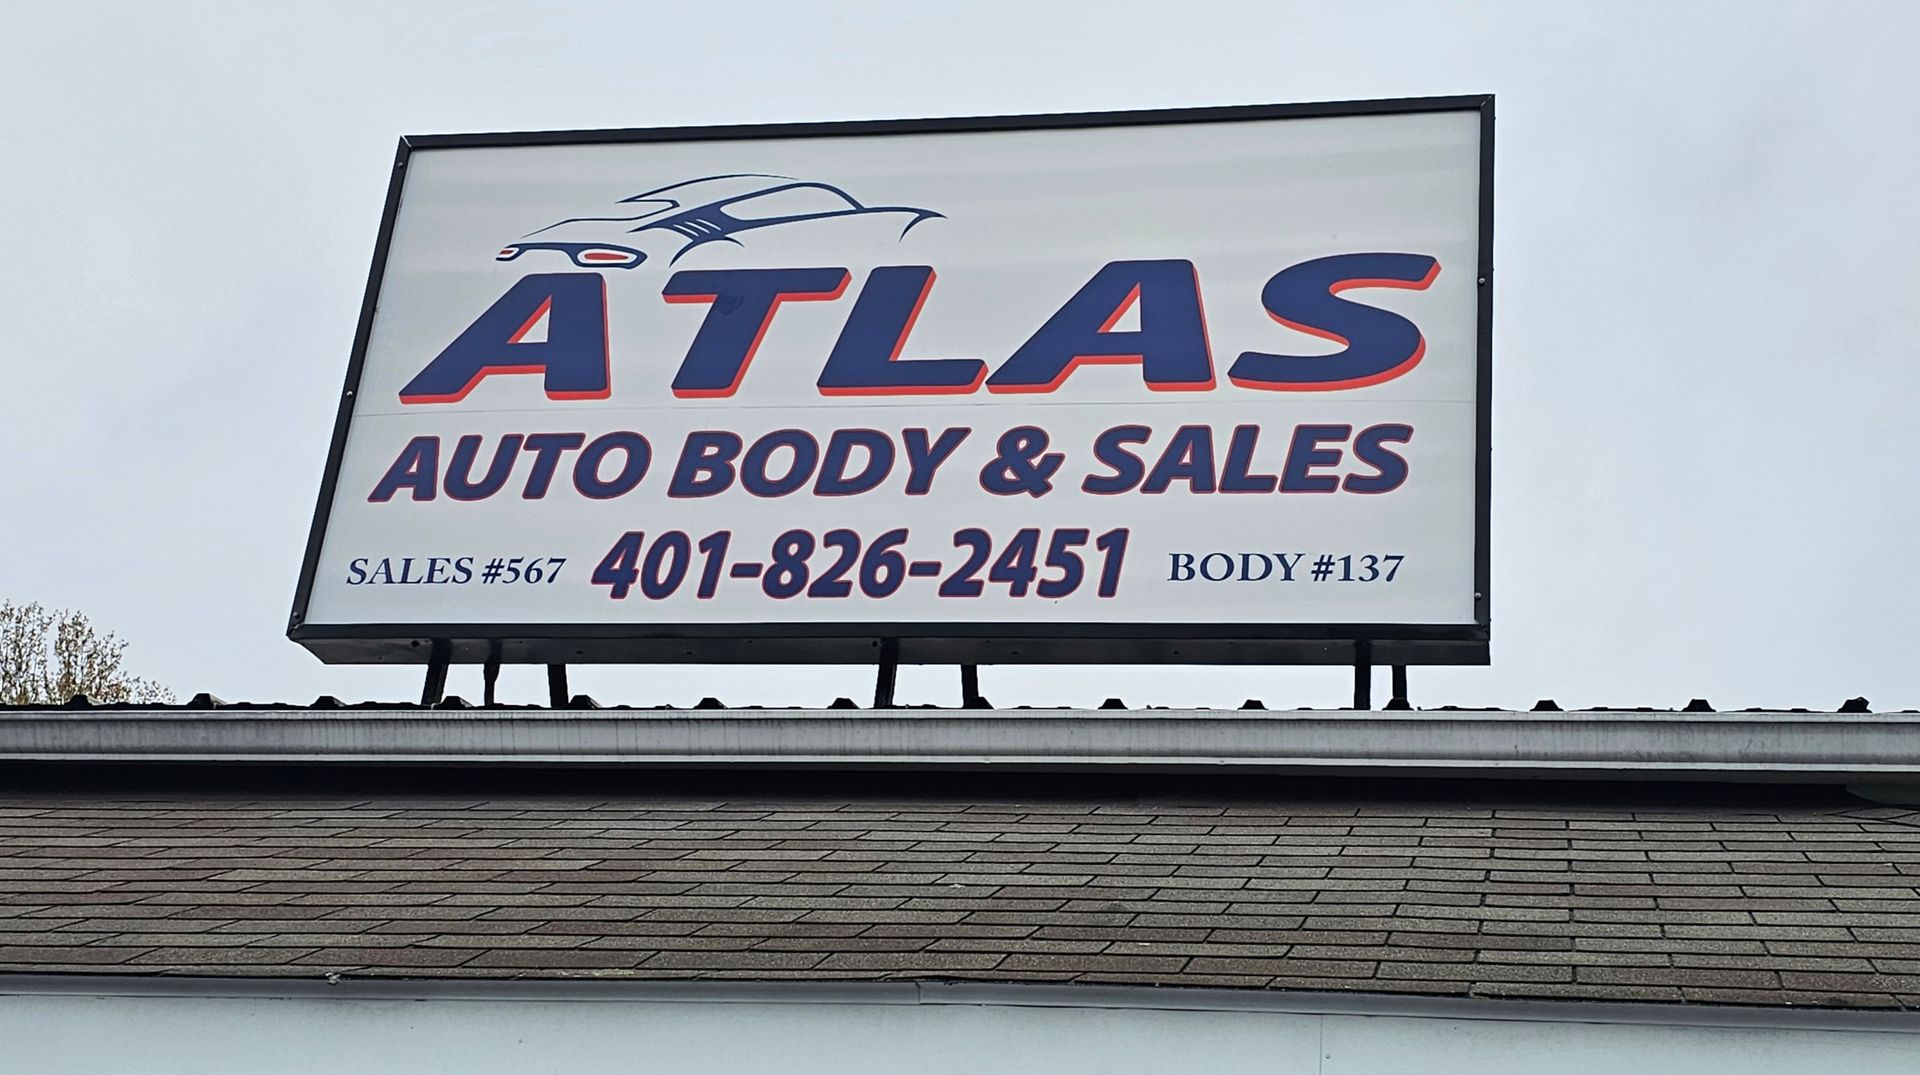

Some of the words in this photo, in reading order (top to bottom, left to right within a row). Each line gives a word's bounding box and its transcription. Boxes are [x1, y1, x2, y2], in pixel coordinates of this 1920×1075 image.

[398, 252, 1441, 404] ATLAS
[367, 430, 653, 502] AUTO
[667, 427, 972, 499] BODY
[979, 425, 1066, 499] &
[1081, 423, 1415, 496] SALES
[345, 557, 474, 586] SALES
[481, 556, 568, 585] #567
[590, 527, 1130, 601] 401-826-2451
[1167, 552, 1305, 582] BODY
[1310, 554, 1405, 583] #137
